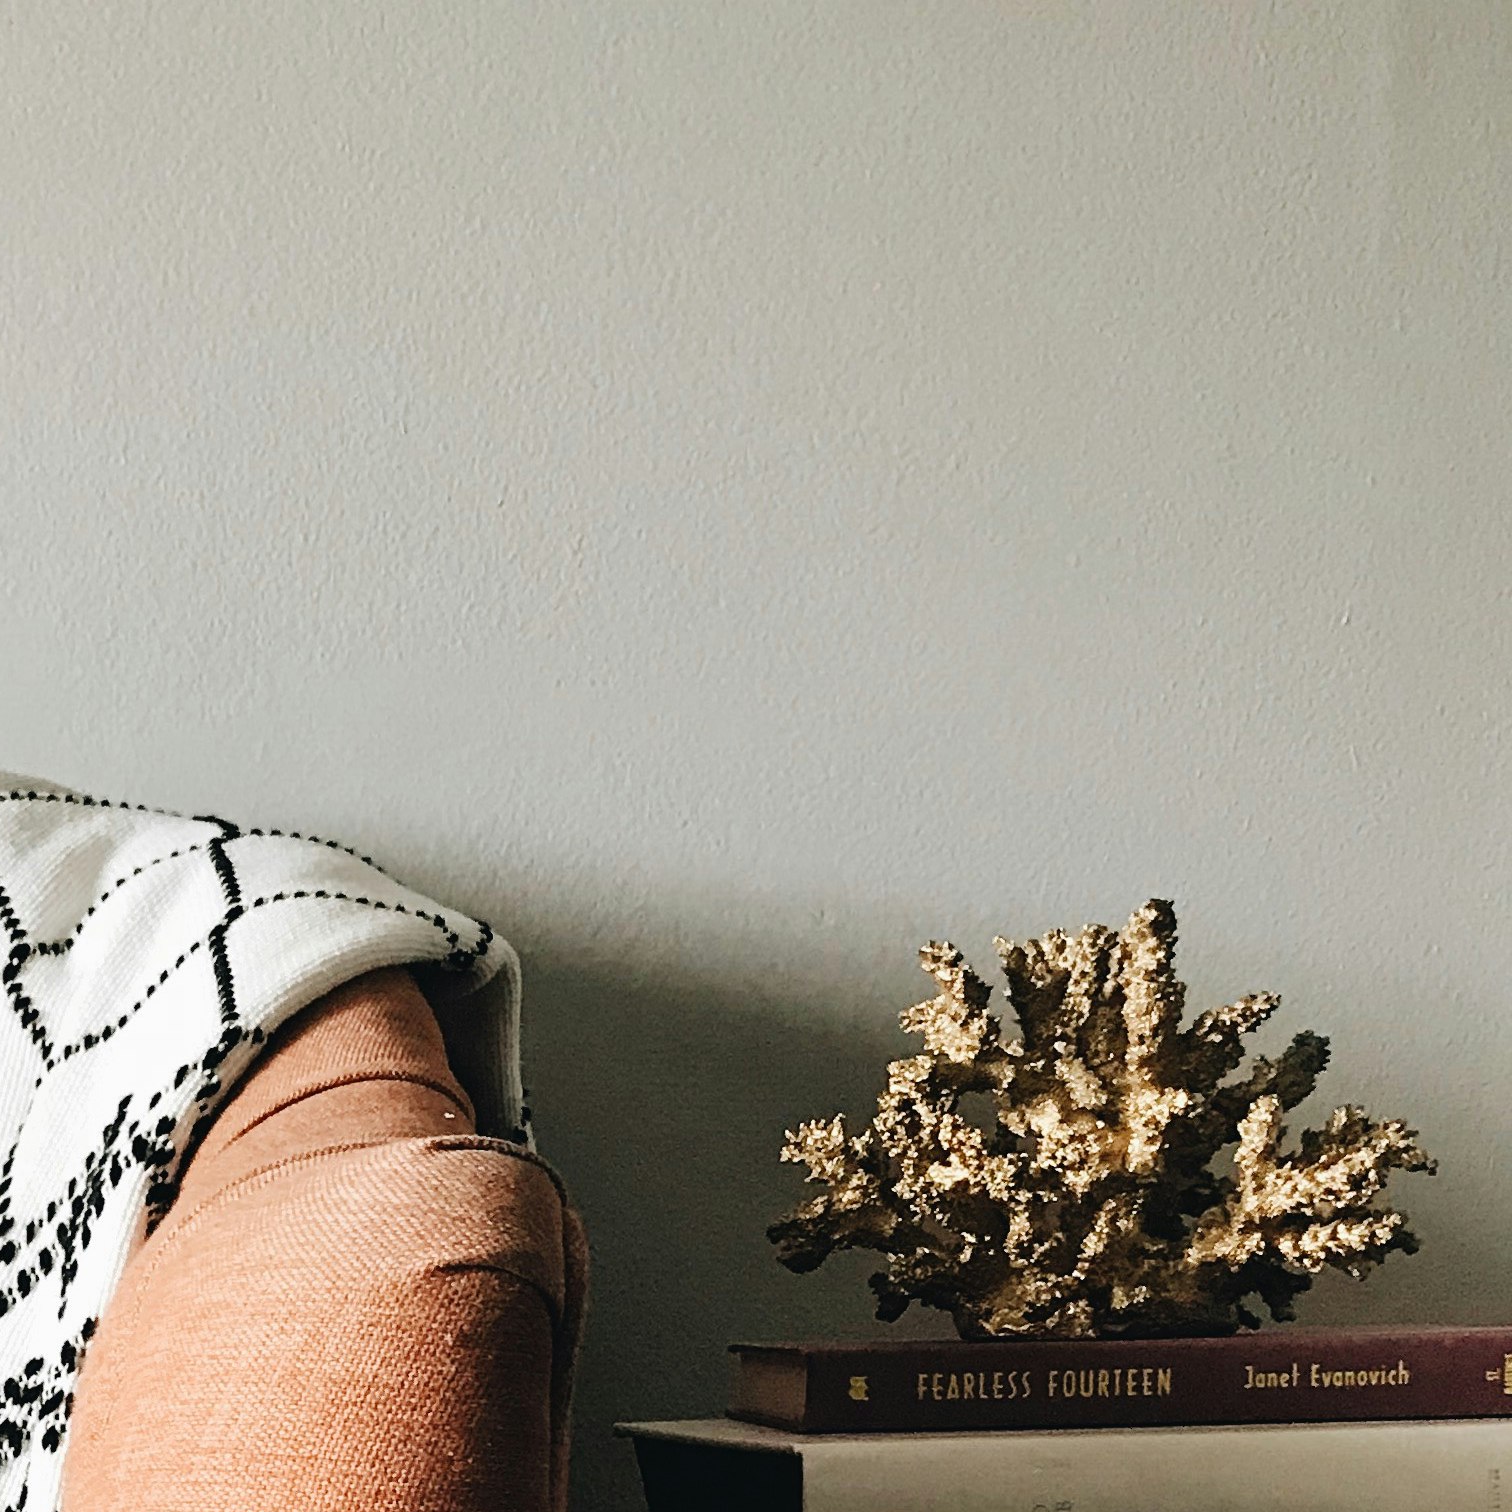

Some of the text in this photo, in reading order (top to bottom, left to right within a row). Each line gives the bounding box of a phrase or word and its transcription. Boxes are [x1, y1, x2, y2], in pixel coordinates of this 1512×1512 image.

[917, 1367, 1173, 1401] FEARLESS FOURTEEN
[1243, 1359, 1411, 1390] Janet Evanovich
